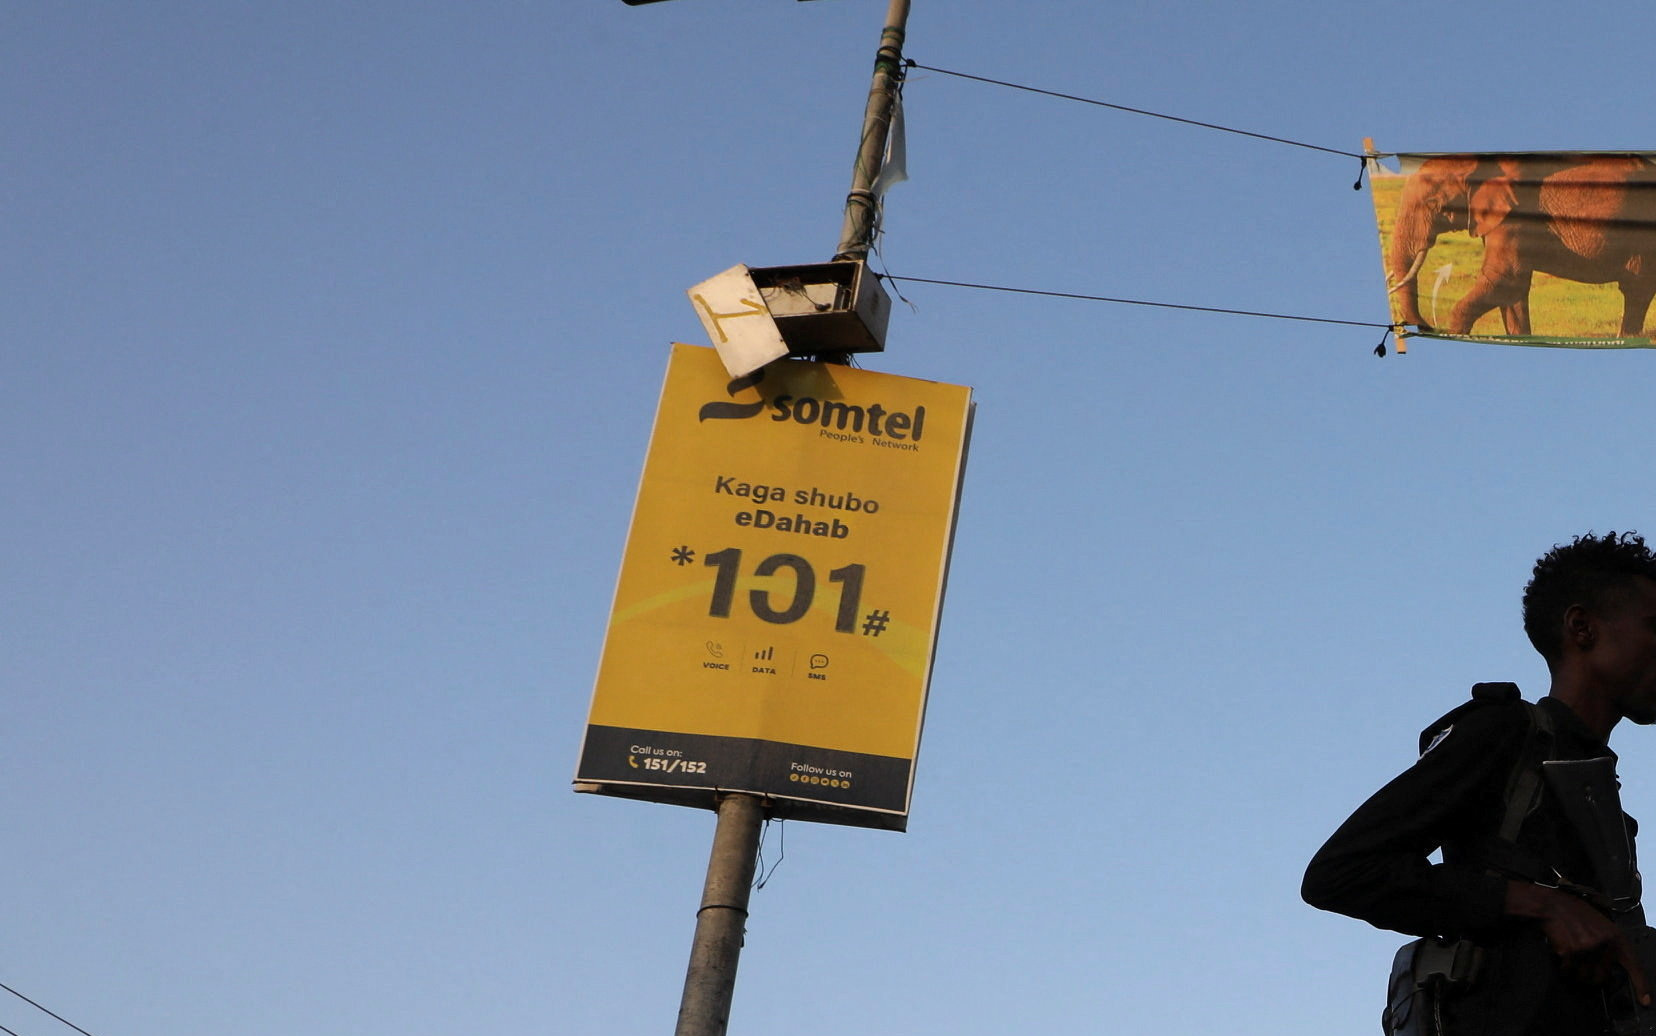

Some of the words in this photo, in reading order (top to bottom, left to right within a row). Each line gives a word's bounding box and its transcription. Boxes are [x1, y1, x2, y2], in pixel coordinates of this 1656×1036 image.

[771, 394, 926, 442] somtel
[818, 428, 865, 445] People's
[871, 436, 920, 453] Network
[714, 475, 786, 504] Kaga
[794, 486, 880, 514] shubo
[735, 509, 850, 540] eDahab
[702, 661, 730, 672] VOICE
[751, 665, 777, 676] DATA
[807, 671, 827, 682] SMS
[630, 744, 651, 755] Call
[653, 748, 665, 756] us
[666, 749, 683, 757] on:
[643, 757, 707, 774] 151/152
[791, 762, 824, 775] Follow
[825, 768, 837, 776] us
[838, 769, 853, 779] on
